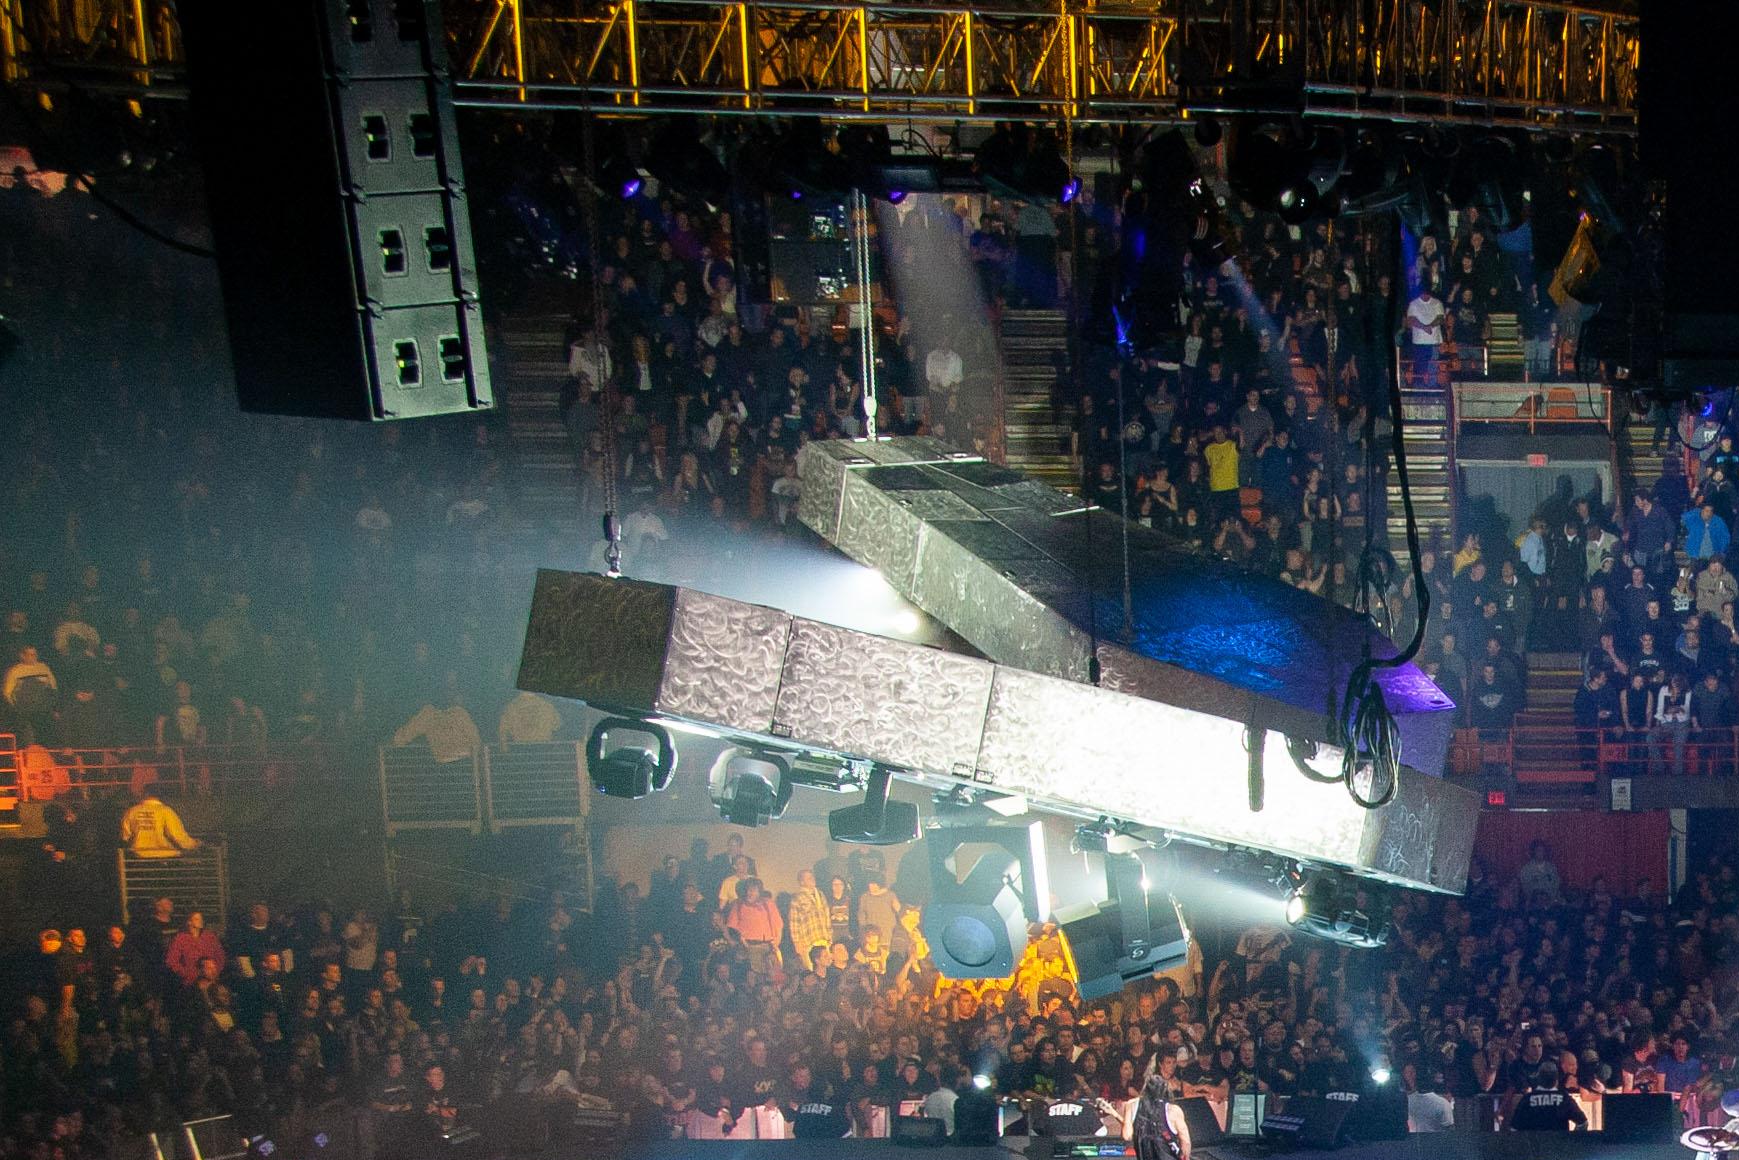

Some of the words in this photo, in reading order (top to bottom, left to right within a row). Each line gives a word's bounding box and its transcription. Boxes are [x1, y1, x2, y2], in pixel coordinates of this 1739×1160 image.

[1325, 1091, 1360, 1103] STAFF
[1529, 1093, 1564, 1107] STAFF
[800, 1103, 832, 1116] STAFF
[1048, 1103, 1083, 1117] STAFF
